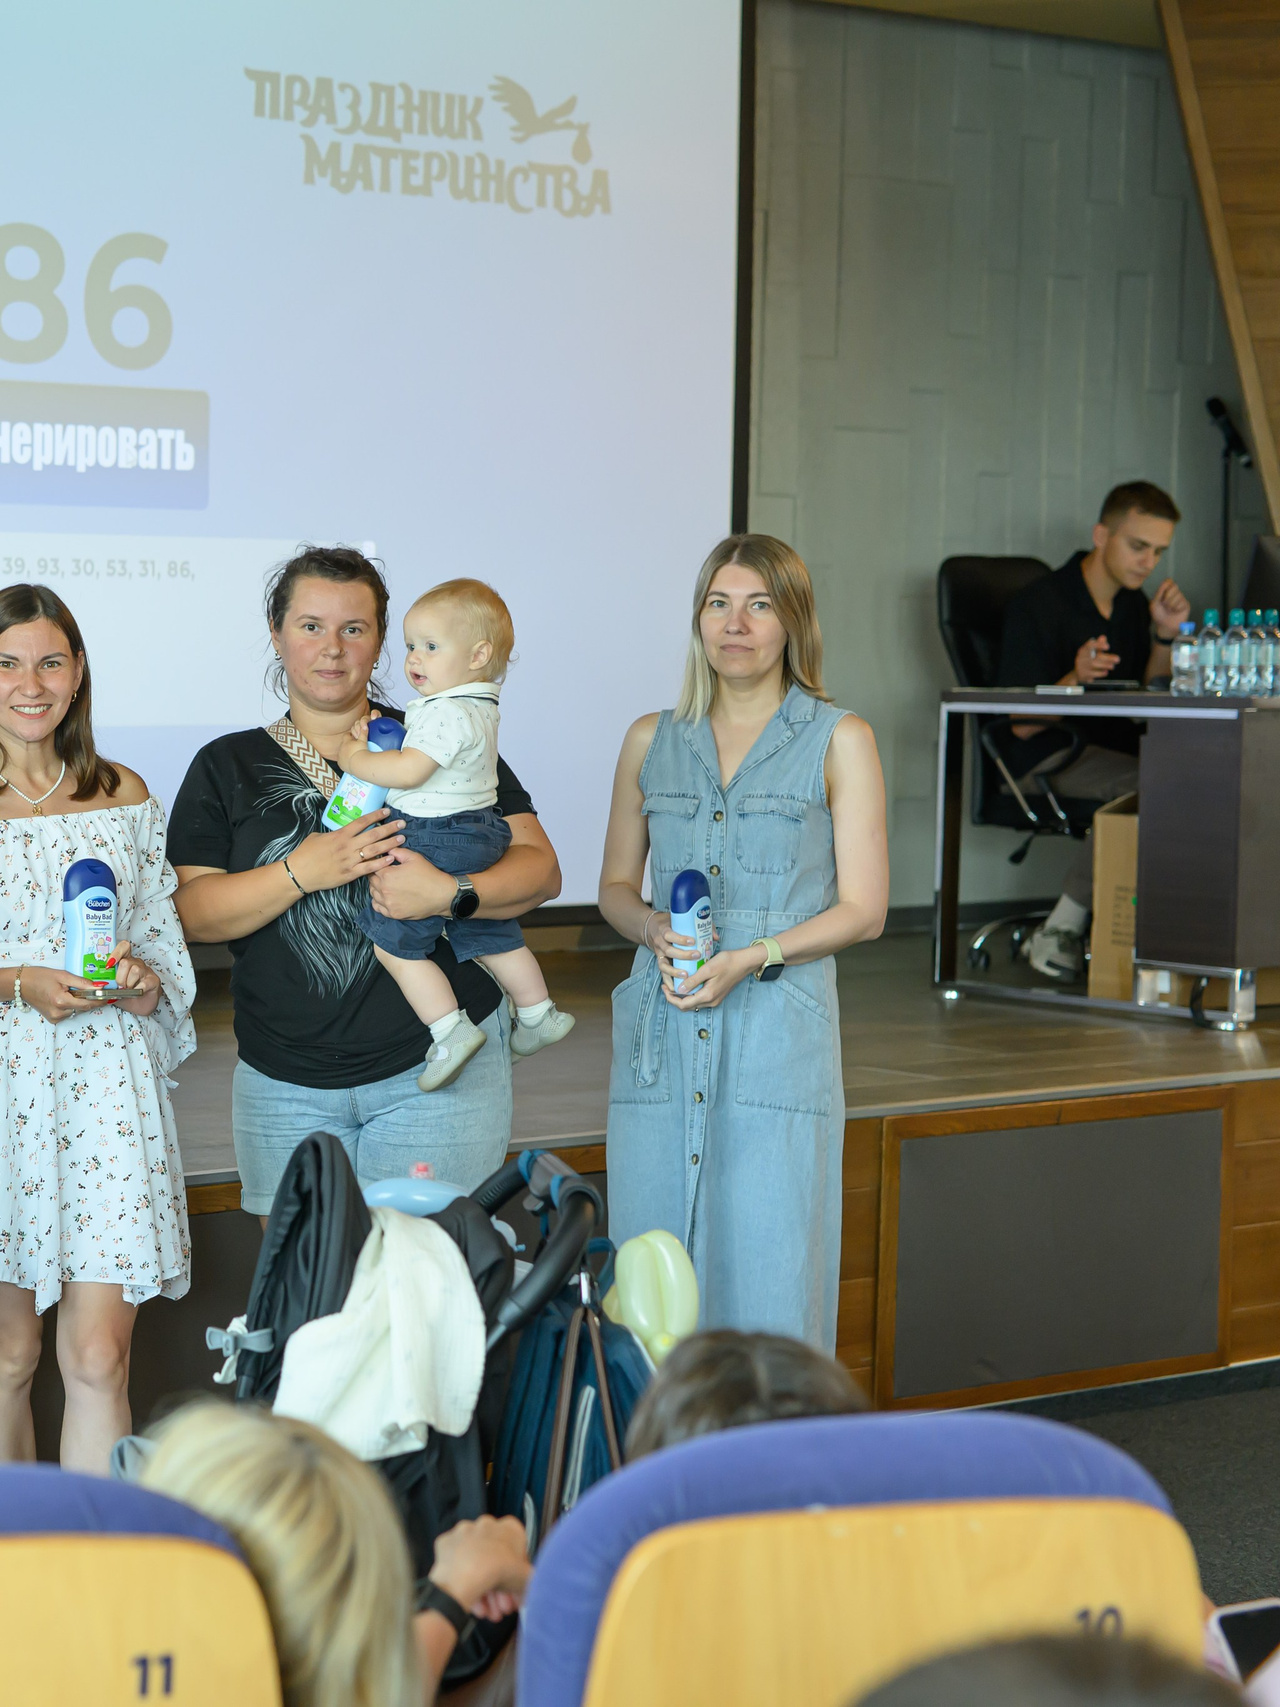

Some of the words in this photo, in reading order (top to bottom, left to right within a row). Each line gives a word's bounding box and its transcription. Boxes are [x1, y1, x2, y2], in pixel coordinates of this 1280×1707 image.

[244, 66, 485, 143] ПРАЗДНИК
[299, 133, 611, 219] МАТЕРИНСТВА
[2, 557, 31, 578] 39,
[36, 557, 65, 579] 93,
[71, 558, 100, 580] 30,
[106, 559, 133, 580] 53,
[138, 559, 161, 581] 31,
[167, 560, 196, 583] 86,
[86, 913, 101, 921] Baby
[133, 1655, 174, 1697] 11
